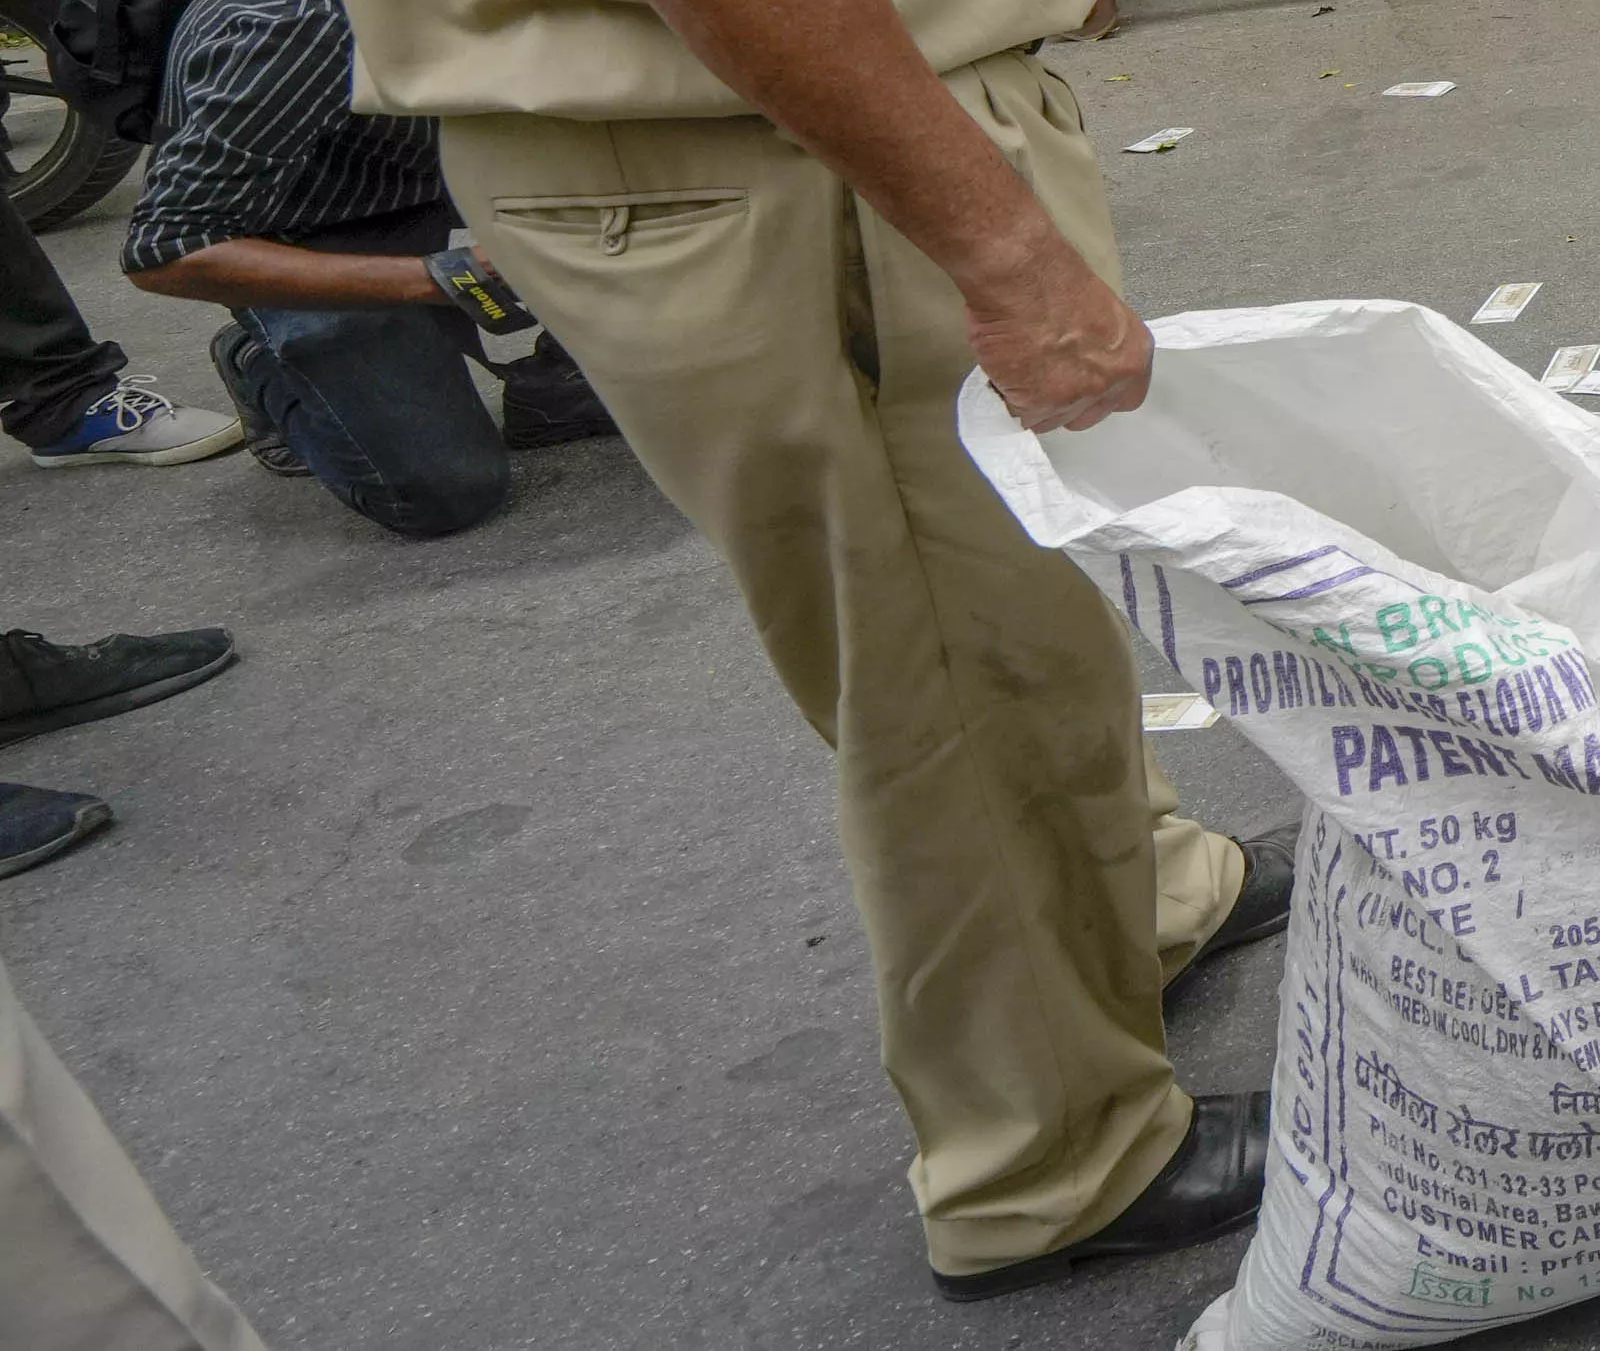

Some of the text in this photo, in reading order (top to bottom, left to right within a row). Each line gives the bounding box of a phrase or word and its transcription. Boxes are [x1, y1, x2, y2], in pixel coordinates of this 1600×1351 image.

[469, 284, 507, 320] Nikon
[1331, 724, 1531, 796] PATENT
[1420, 814, 1461, 850] 50
[1473, 811, 1517, 844] kg
[1403, 860, 1472, 899] NO.
[1482, 850, 1501, 883] 2
[1391, 954, 1438, 998] BEST
[1451, 1017, 1496, 1056] COOL,
[1496, 1025, 1529, 1059] DRY
[1532, 1033, 1544, 1061] &
[1383, 1186, 1542, 1251] CUSTOMER
[1484, 1197, 1549, 1229] Area,
[1417, 1234, 1509, 1274] E-mail
[1517, 1285, 1556, 1302] No
